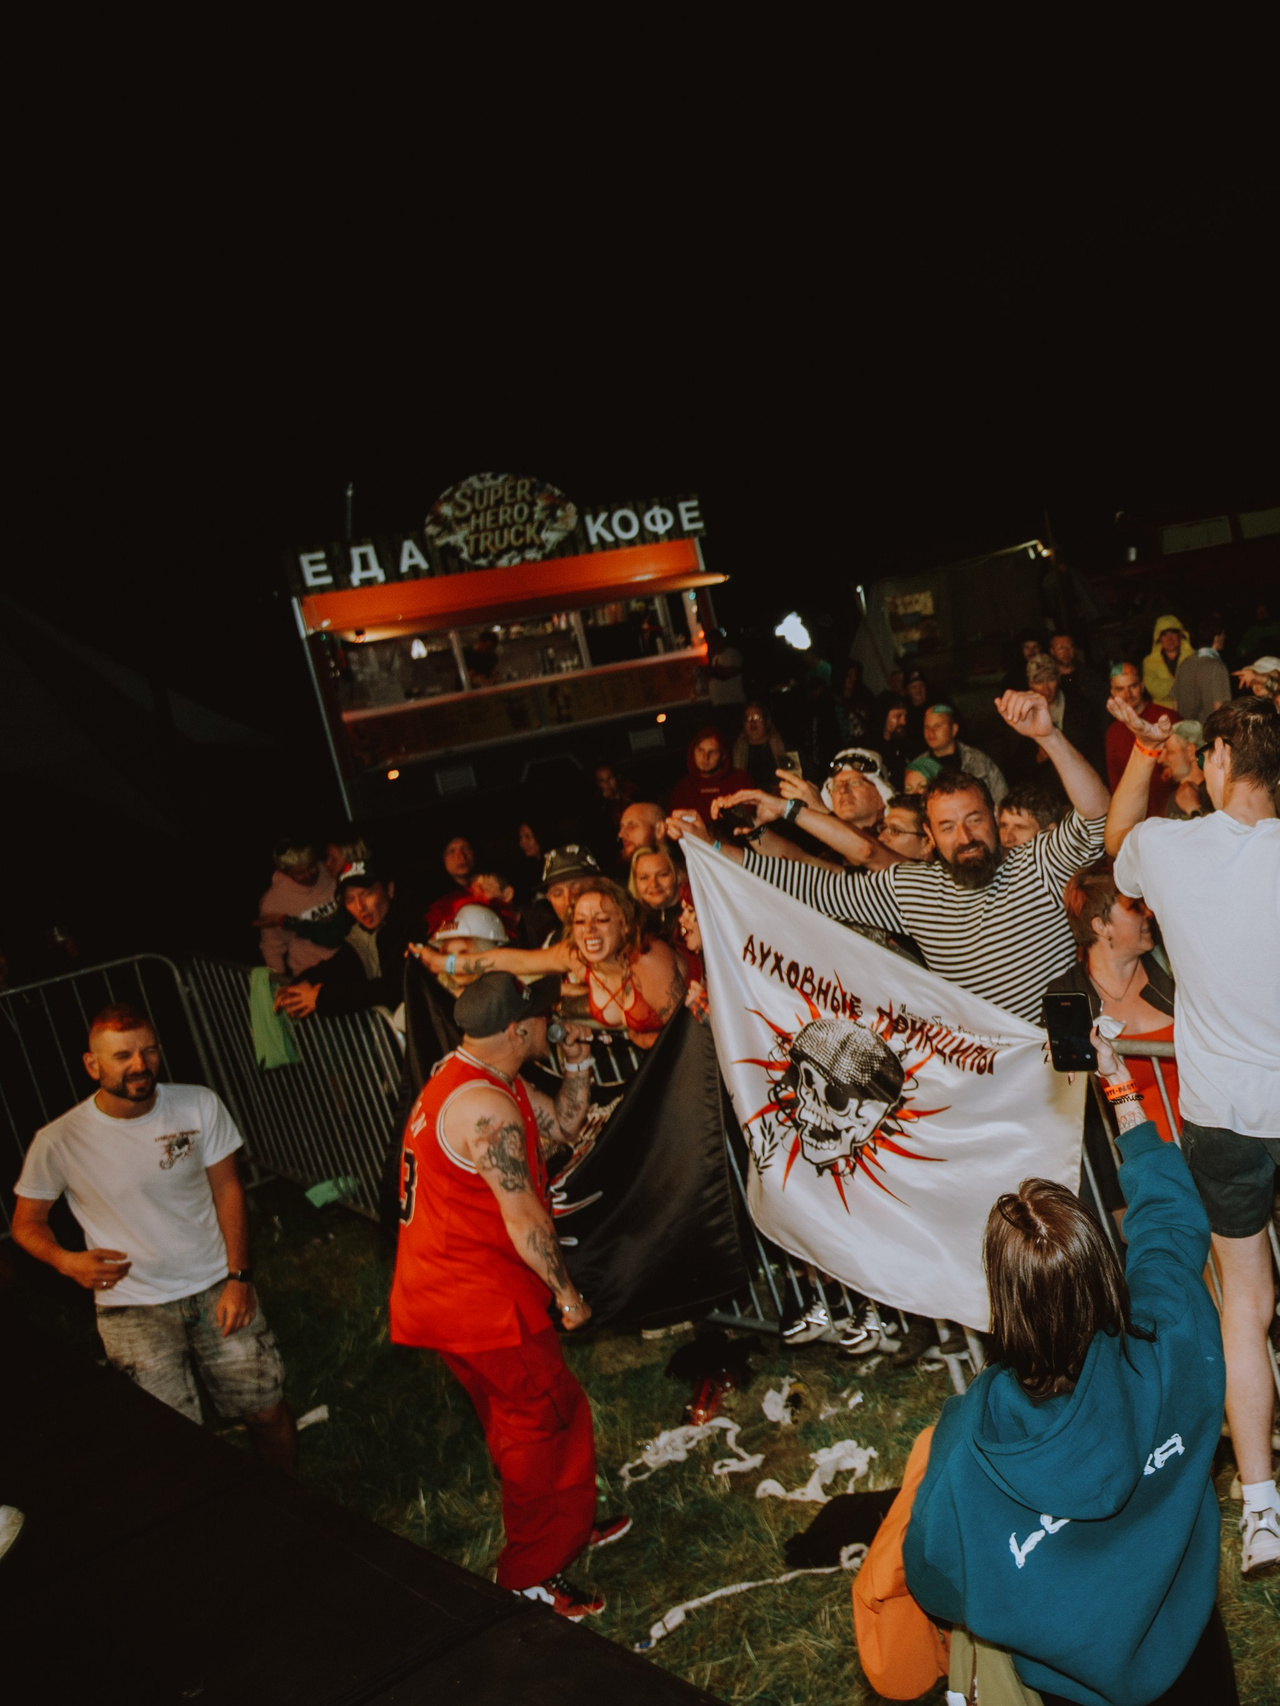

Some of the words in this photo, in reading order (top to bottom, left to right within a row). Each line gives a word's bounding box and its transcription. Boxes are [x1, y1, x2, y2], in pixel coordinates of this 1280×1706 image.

[453, 478, 532, 518] SUPER
[470, 502, 530, 532] HERO
[466, 520, 542, 555] TRUCK
[584, 499, 705, 545] КОФЕ
[299, 538, 430, 588] ЕДА
